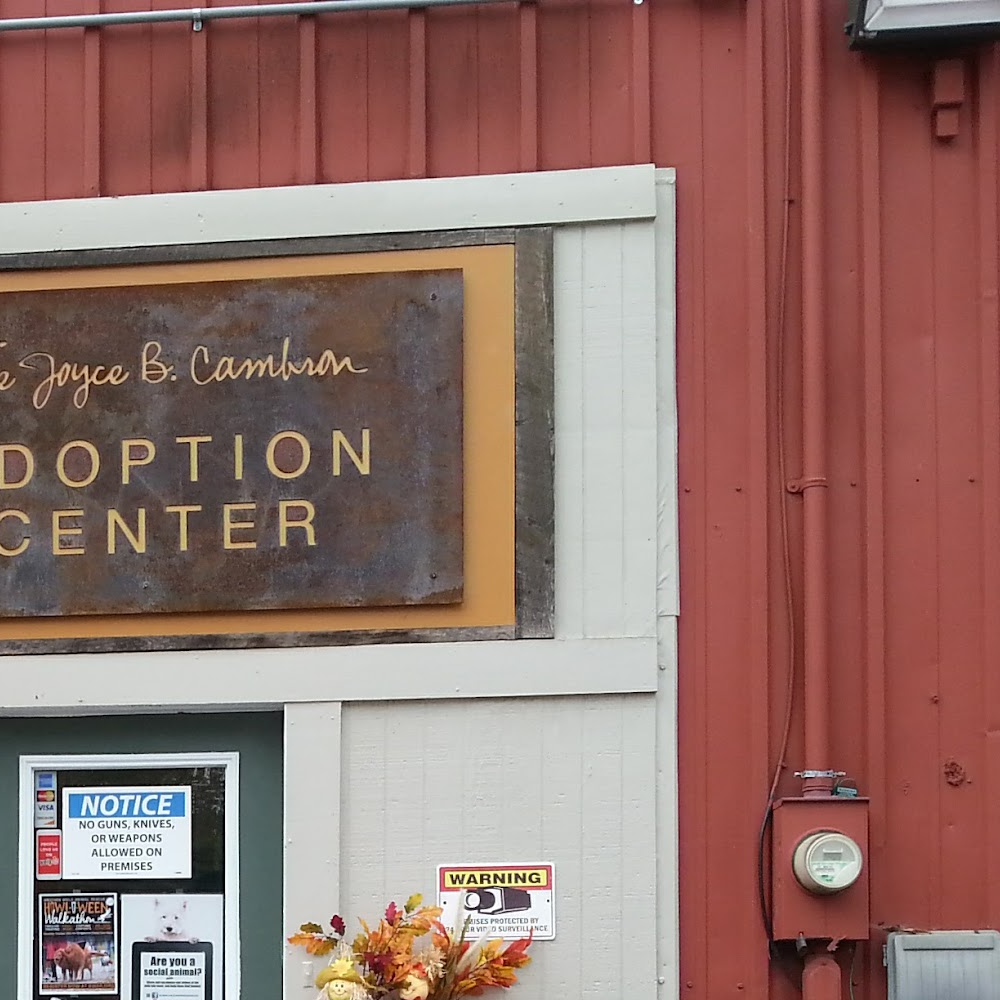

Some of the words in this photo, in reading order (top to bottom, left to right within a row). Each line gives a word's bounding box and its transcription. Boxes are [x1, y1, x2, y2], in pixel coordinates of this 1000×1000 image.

[19, 350, 130, 409] Joyce
[141, 342, 177, 384] B.
[190, 337, 368, 385] Cambron
[80, 794, 173, 816] NOTICE
[79, 820, 95, 829] NO
[98, 820, 130, 830] GUNS,
[134, 820, 175, 830] KNIVES,
[92, 834, 106, 843] OR
[109, 834, 162, 842] WEAPONS
[92, 848, 144, 857] ALLOWED
[146, 848, 162, 856] ON
[101, 862, 153, 871] PREMISES
[450, 873, 542, 884] WARNING
[150, 956, 167, 966] Are
[170, 958, 187, 967] you
[190, 958, 196, 966] a
[170, 968, 202, 976] animal?
